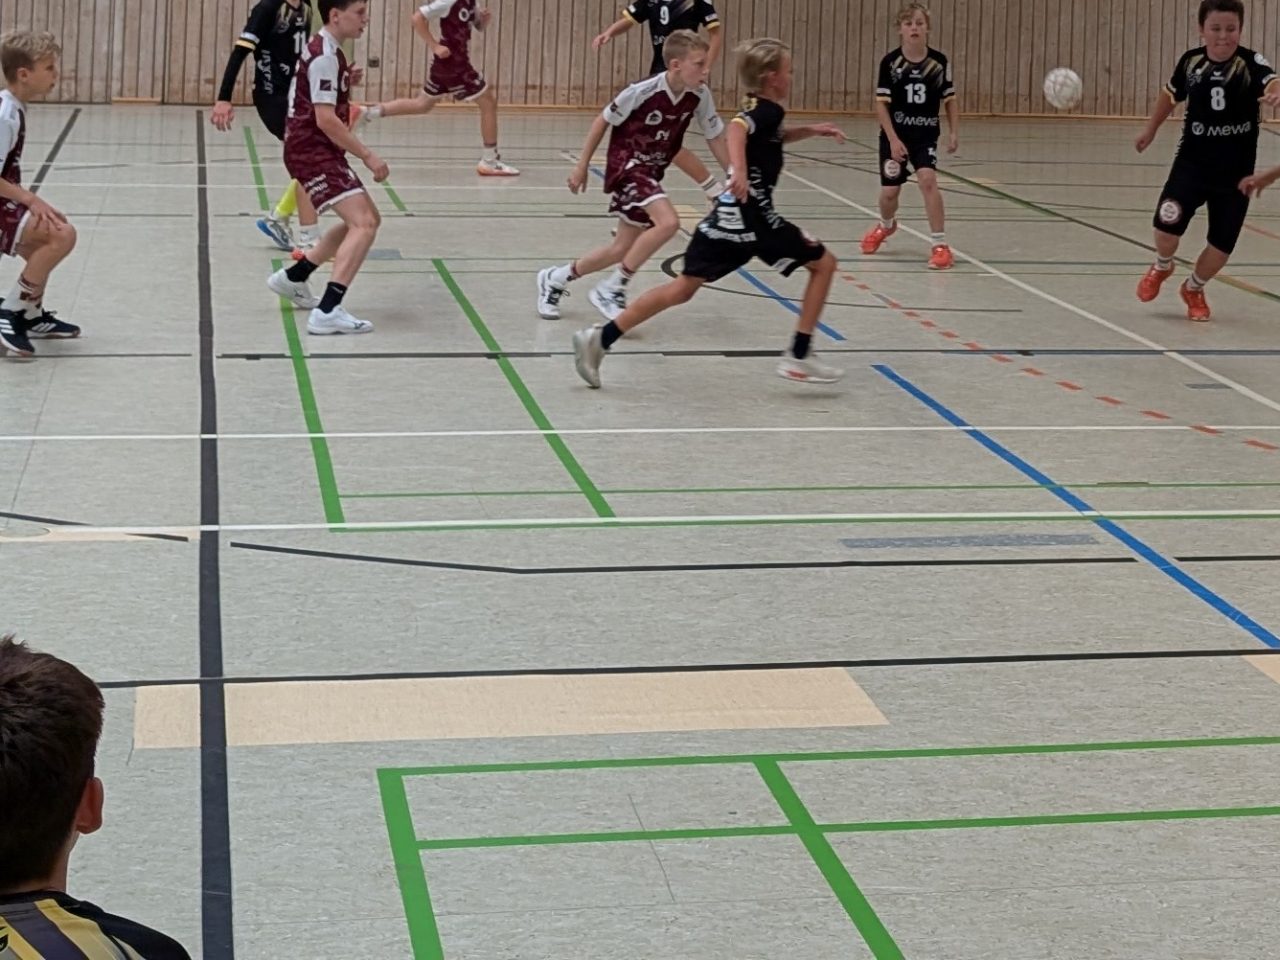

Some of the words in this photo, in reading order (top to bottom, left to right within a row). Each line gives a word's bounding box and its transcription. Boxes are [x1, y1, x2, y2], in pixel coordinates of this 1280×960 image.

[660, 5, 670, 25] 9
[904, 82, 927, 104] 13
[1210, 86, 1227, 111] 8
